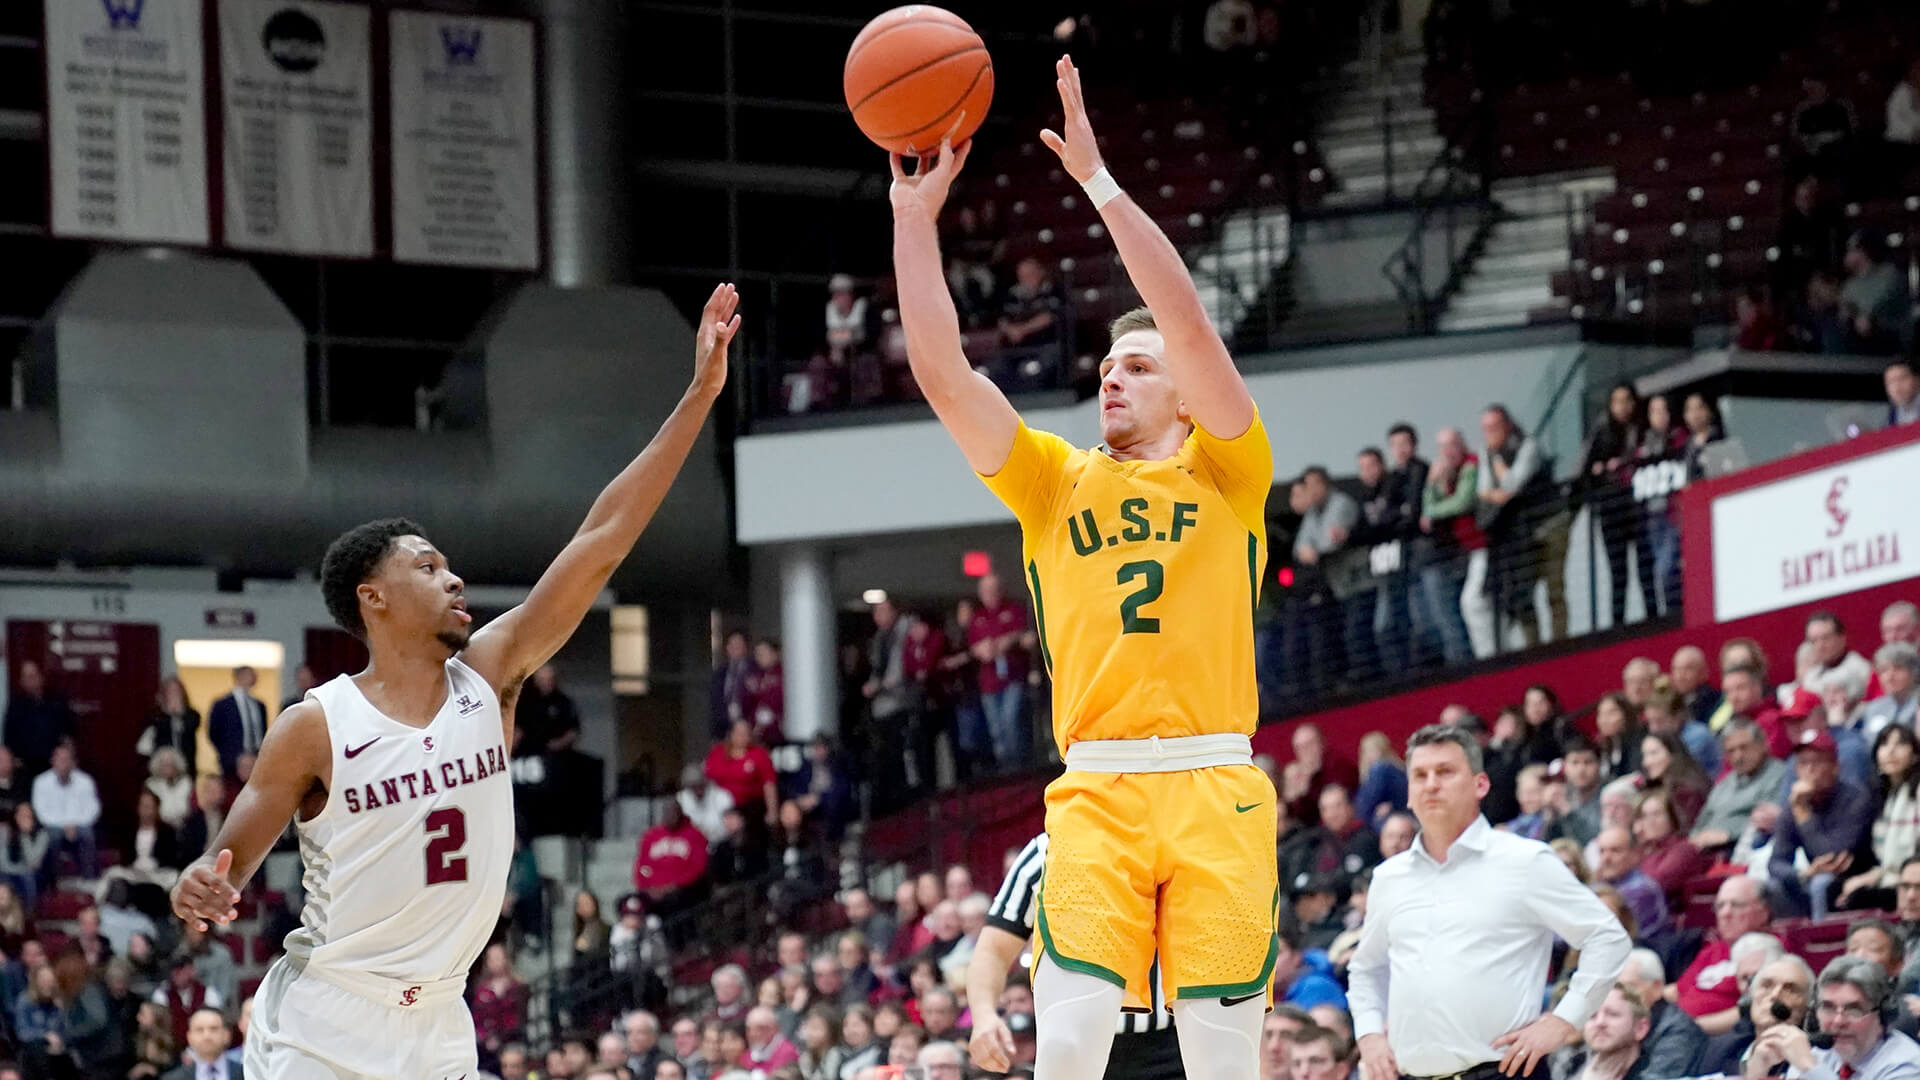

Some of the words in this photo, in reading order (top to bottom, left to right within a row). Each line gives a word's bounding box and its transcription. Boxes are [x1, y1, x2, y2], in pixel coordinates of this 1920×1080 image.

[1068, 498, 1198, 556] U.S.F
[1782, 550, 1836, 589] SANTA
[1842, 532, 1901, 574] CLARA
[1116, 560, 1164, 635] 2
[344, 769, 437, 814] SANTA
[440, 745, 507, 789] CLARA
[424, 805, 469, 887] 2
